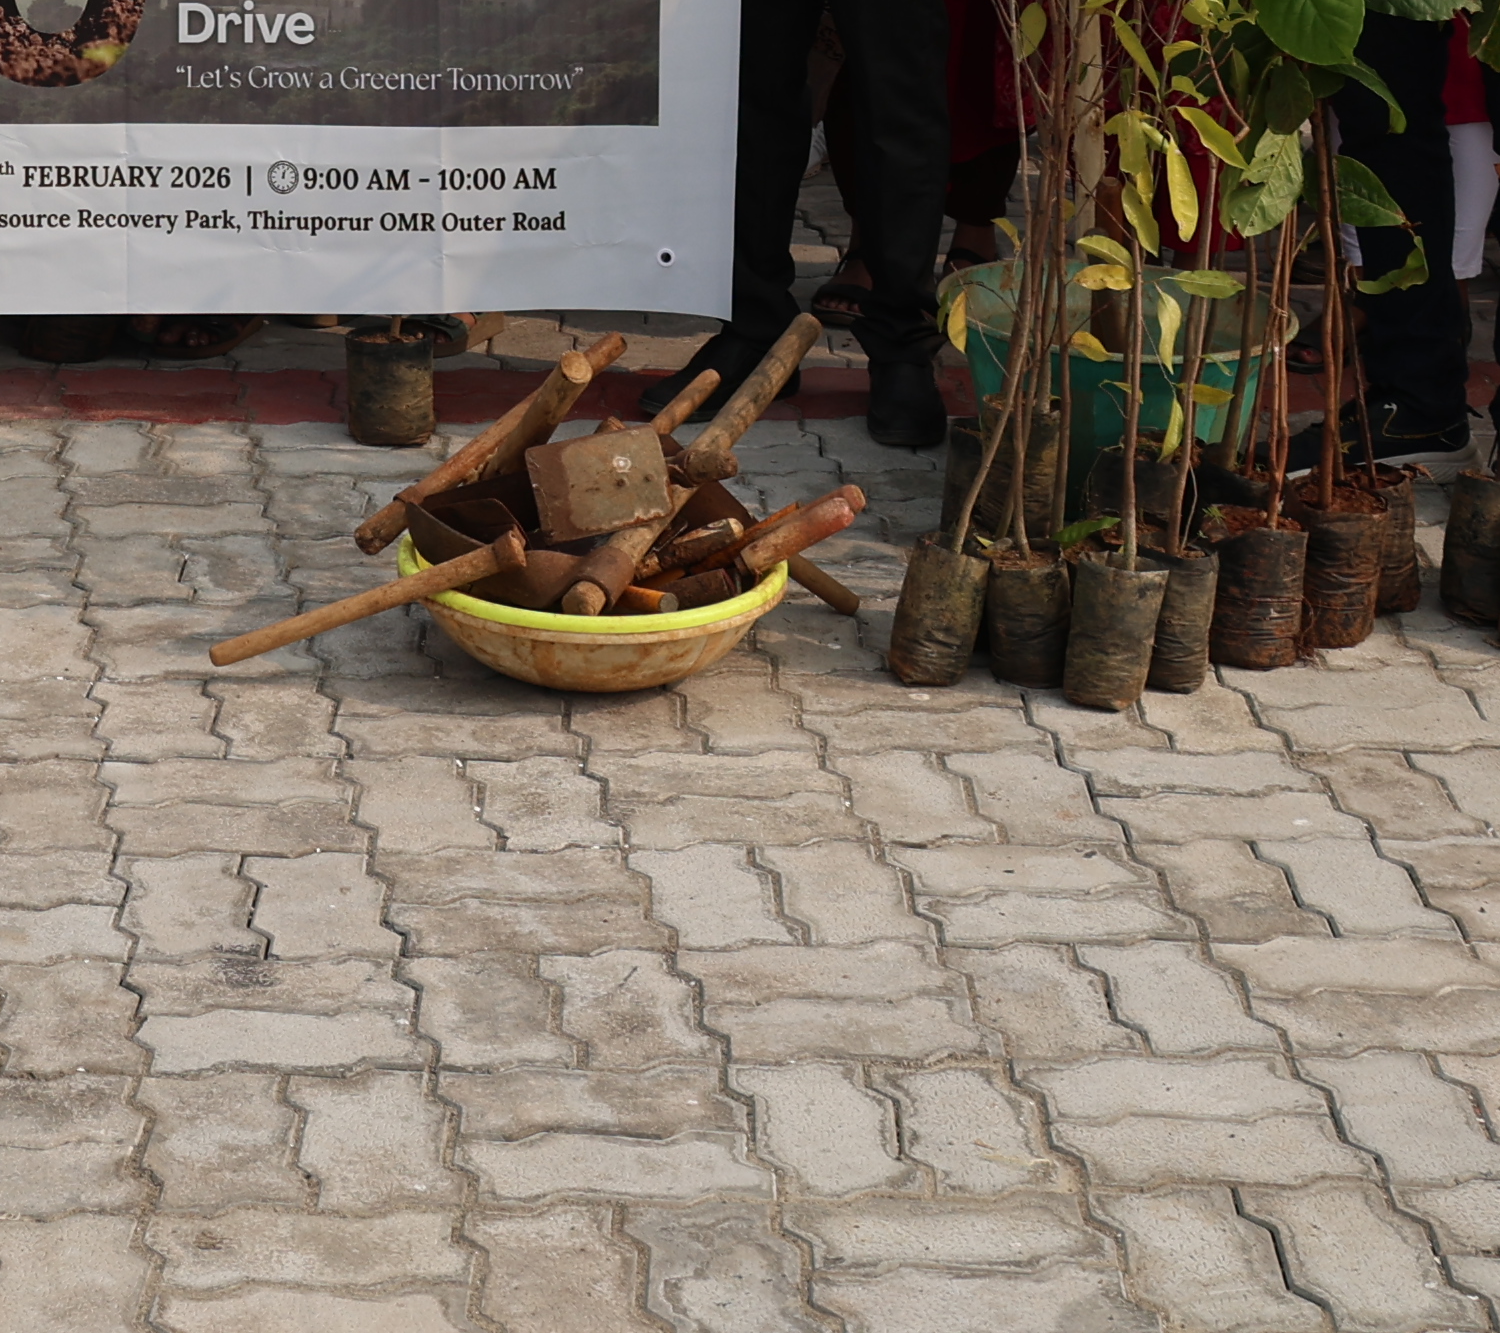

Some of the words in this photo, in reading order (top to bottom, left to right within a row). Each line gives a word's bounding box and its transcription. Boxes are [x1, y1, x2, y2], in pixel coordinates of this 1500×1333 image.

[178, 0, 315, 45] Drive
[248, 65, 313, 90] Grow
[318, 71, 334, 90] a
[340, 67, 442, 91] Greener
[22, 165, 163, 188] FEBRUARY
[170, 166, 231, 188] 2026
[303, 167, 359, 191] 9:00
[366, 168, 410, 191] AM
[438, 167, 506, 191] 10:00
[513, 167, 557, 190] AM
[77, 209, 179, 234] Recovery
[185, 209, 242, 233] Park,
[247, 210, 374, 236] Thiruporur
[379, 212, 436, 232] OMR
[441, 212, 506, 232] Outer
[512, 210, 567, 232] Road
